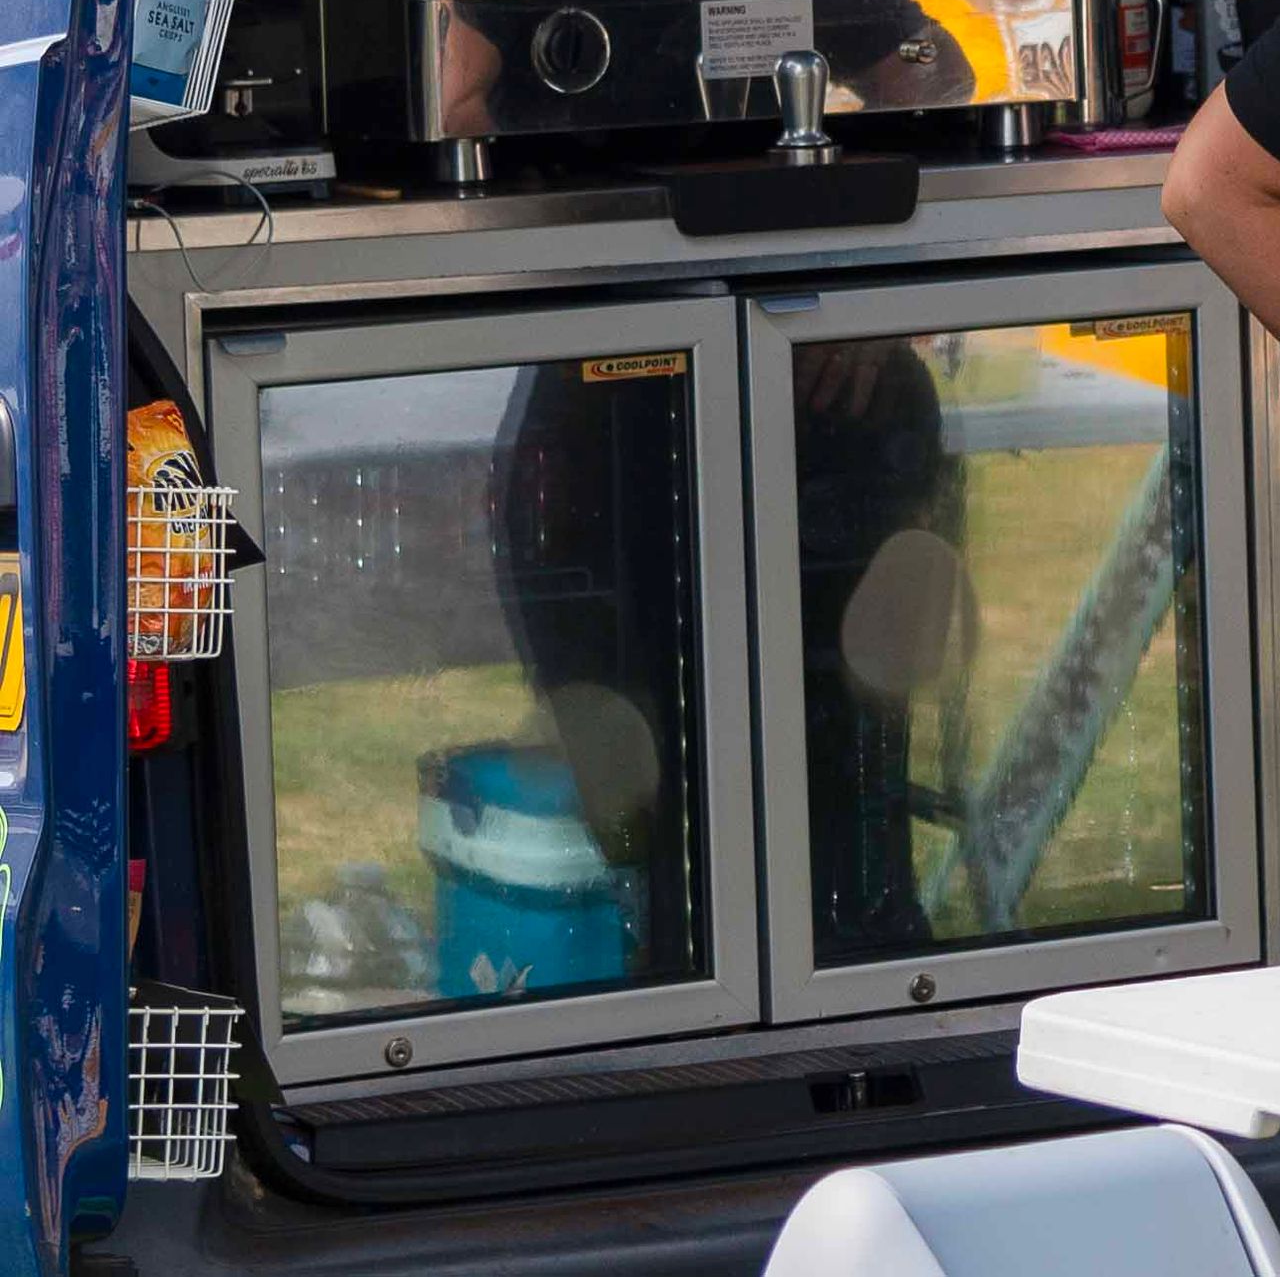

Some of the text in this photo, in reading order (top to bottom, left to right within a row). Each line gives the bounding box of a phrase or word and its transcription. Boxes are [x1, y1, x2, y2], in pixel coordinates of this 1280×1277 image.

[148, 11, 195, 36] SEA SALT
[616, 357, 677, 371] COOLPOINT
